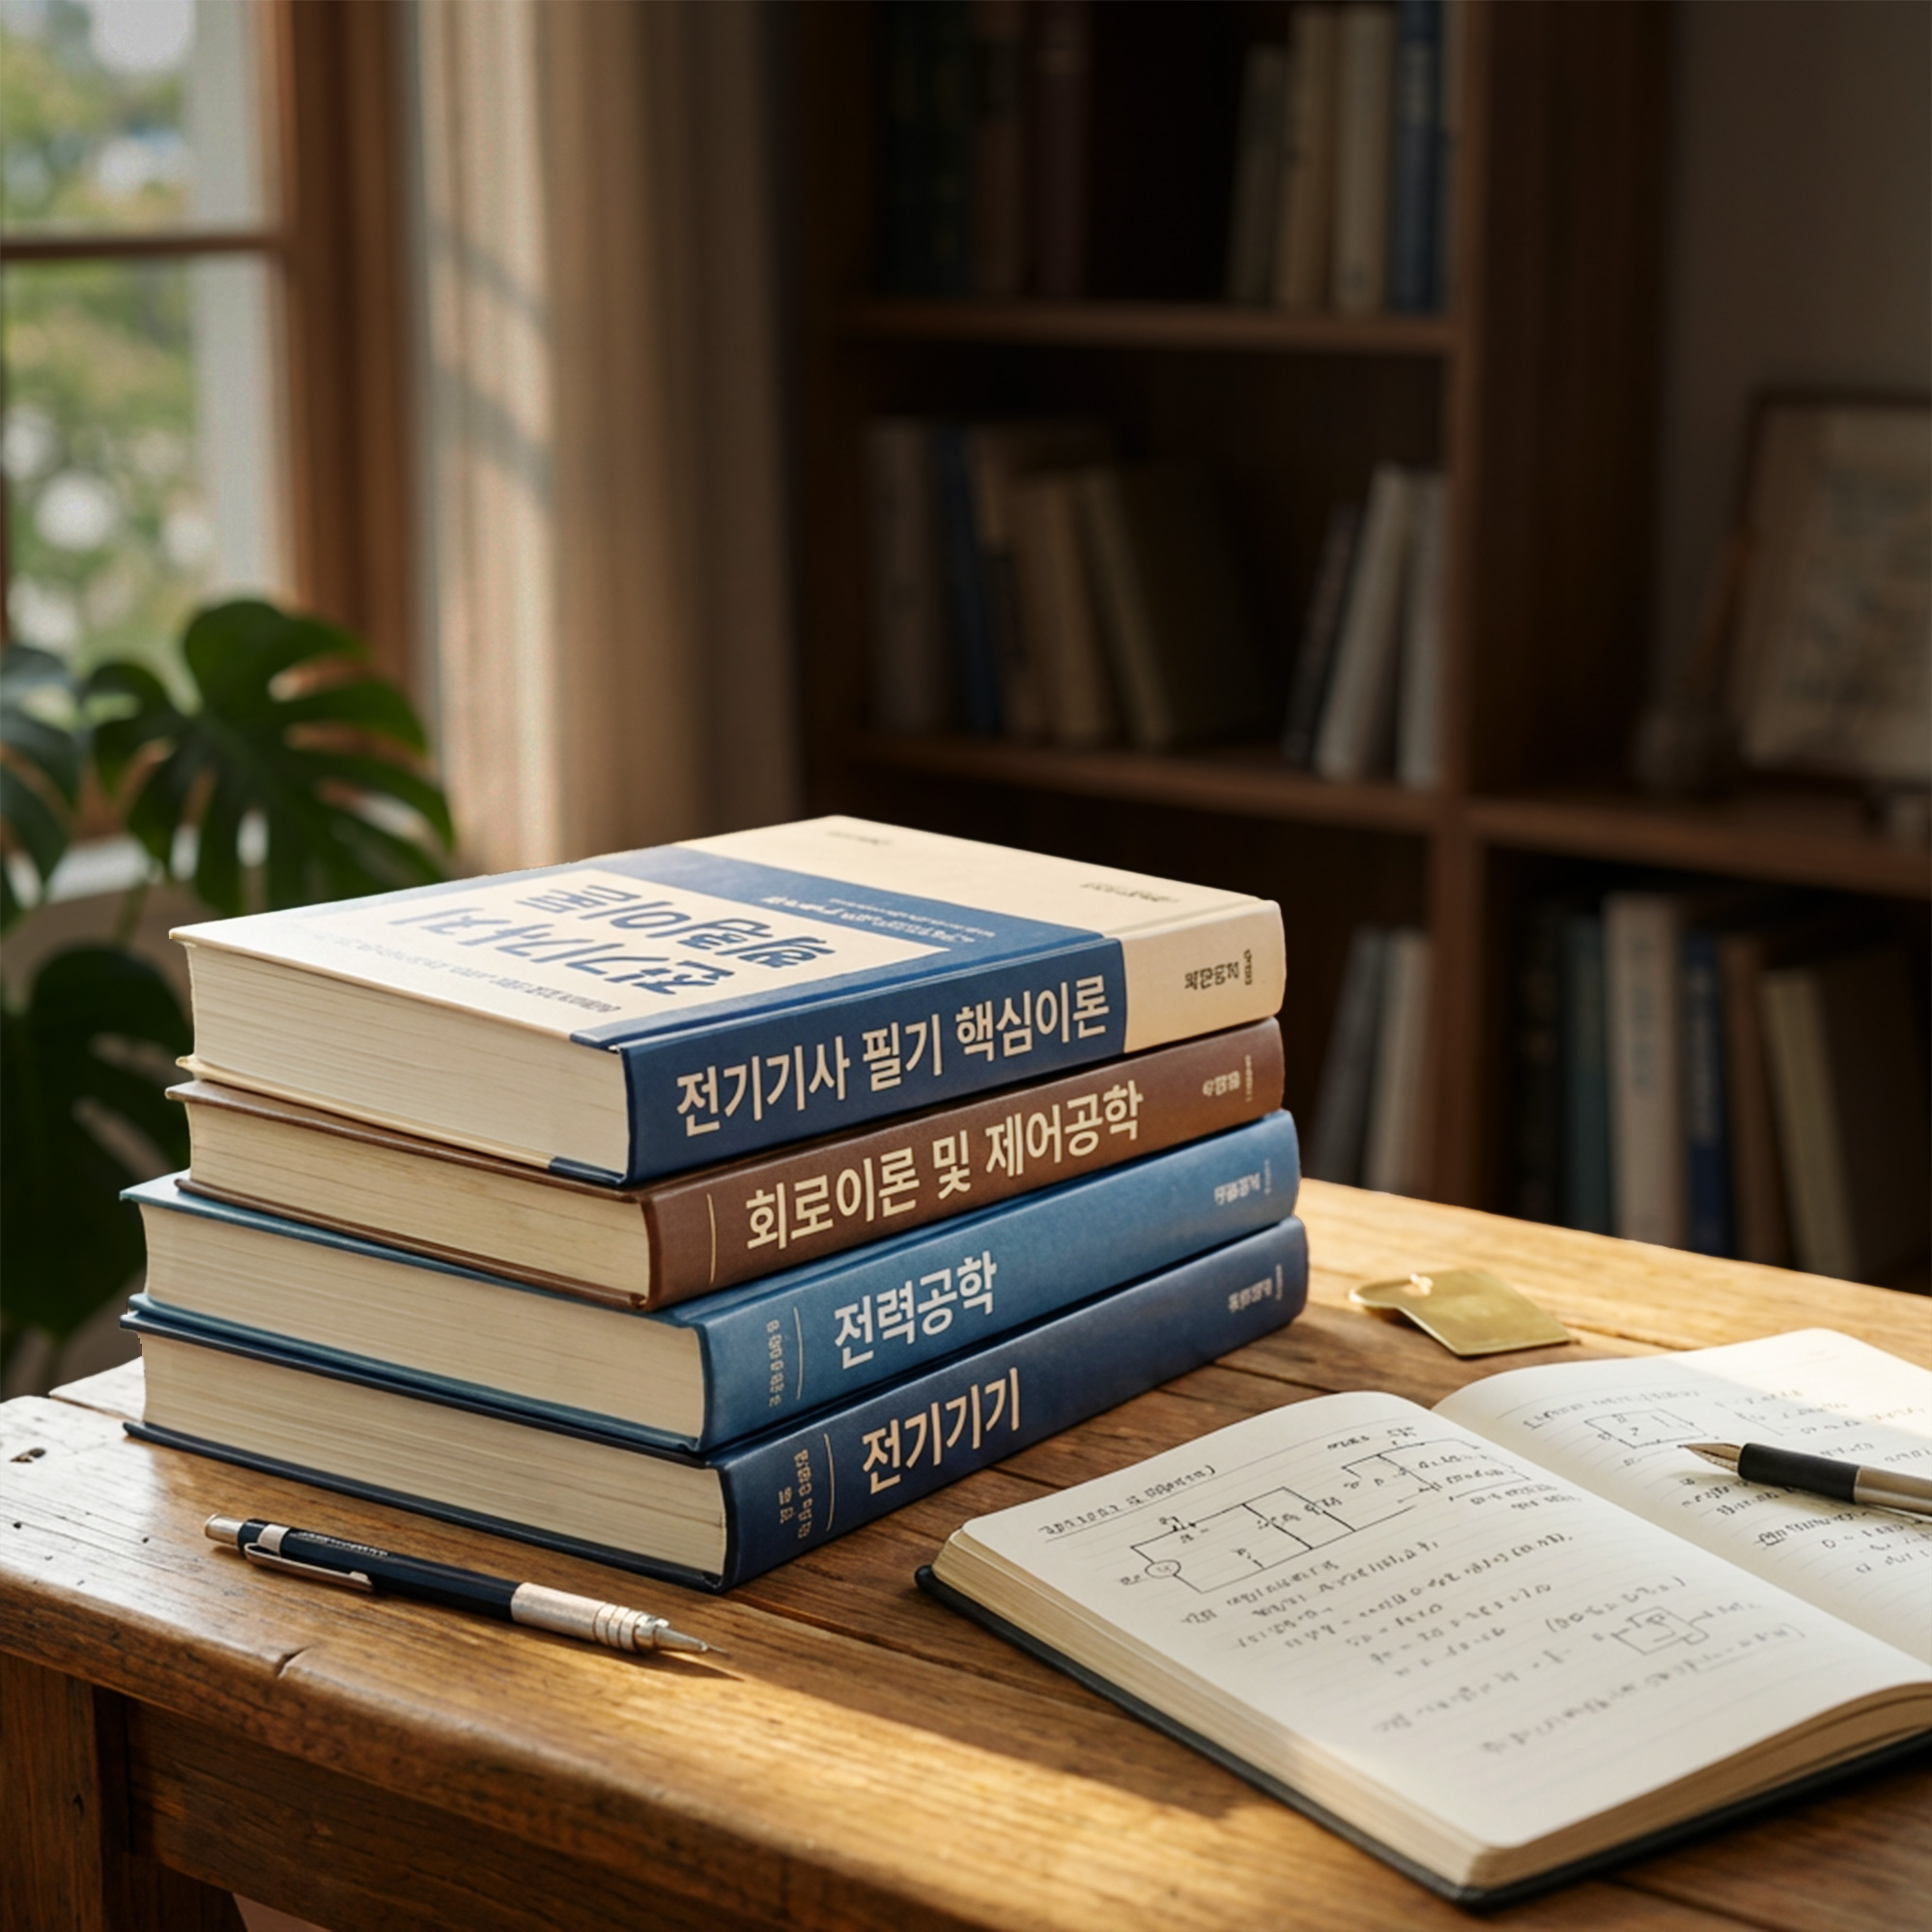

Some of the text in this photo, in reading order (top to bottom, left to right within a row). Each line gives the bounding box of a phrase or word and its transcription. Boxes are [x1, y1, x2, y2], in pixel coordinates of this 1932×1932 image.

[677, 975, 1110, 1137] 전기기사 필기 핵심이론
[745, 1079, 1144, 1250] 회로이론 및 제어공학
[834, 1250, 998, 1369] 전력공학
[862, 1367, 1019, 1494] 전기기기
